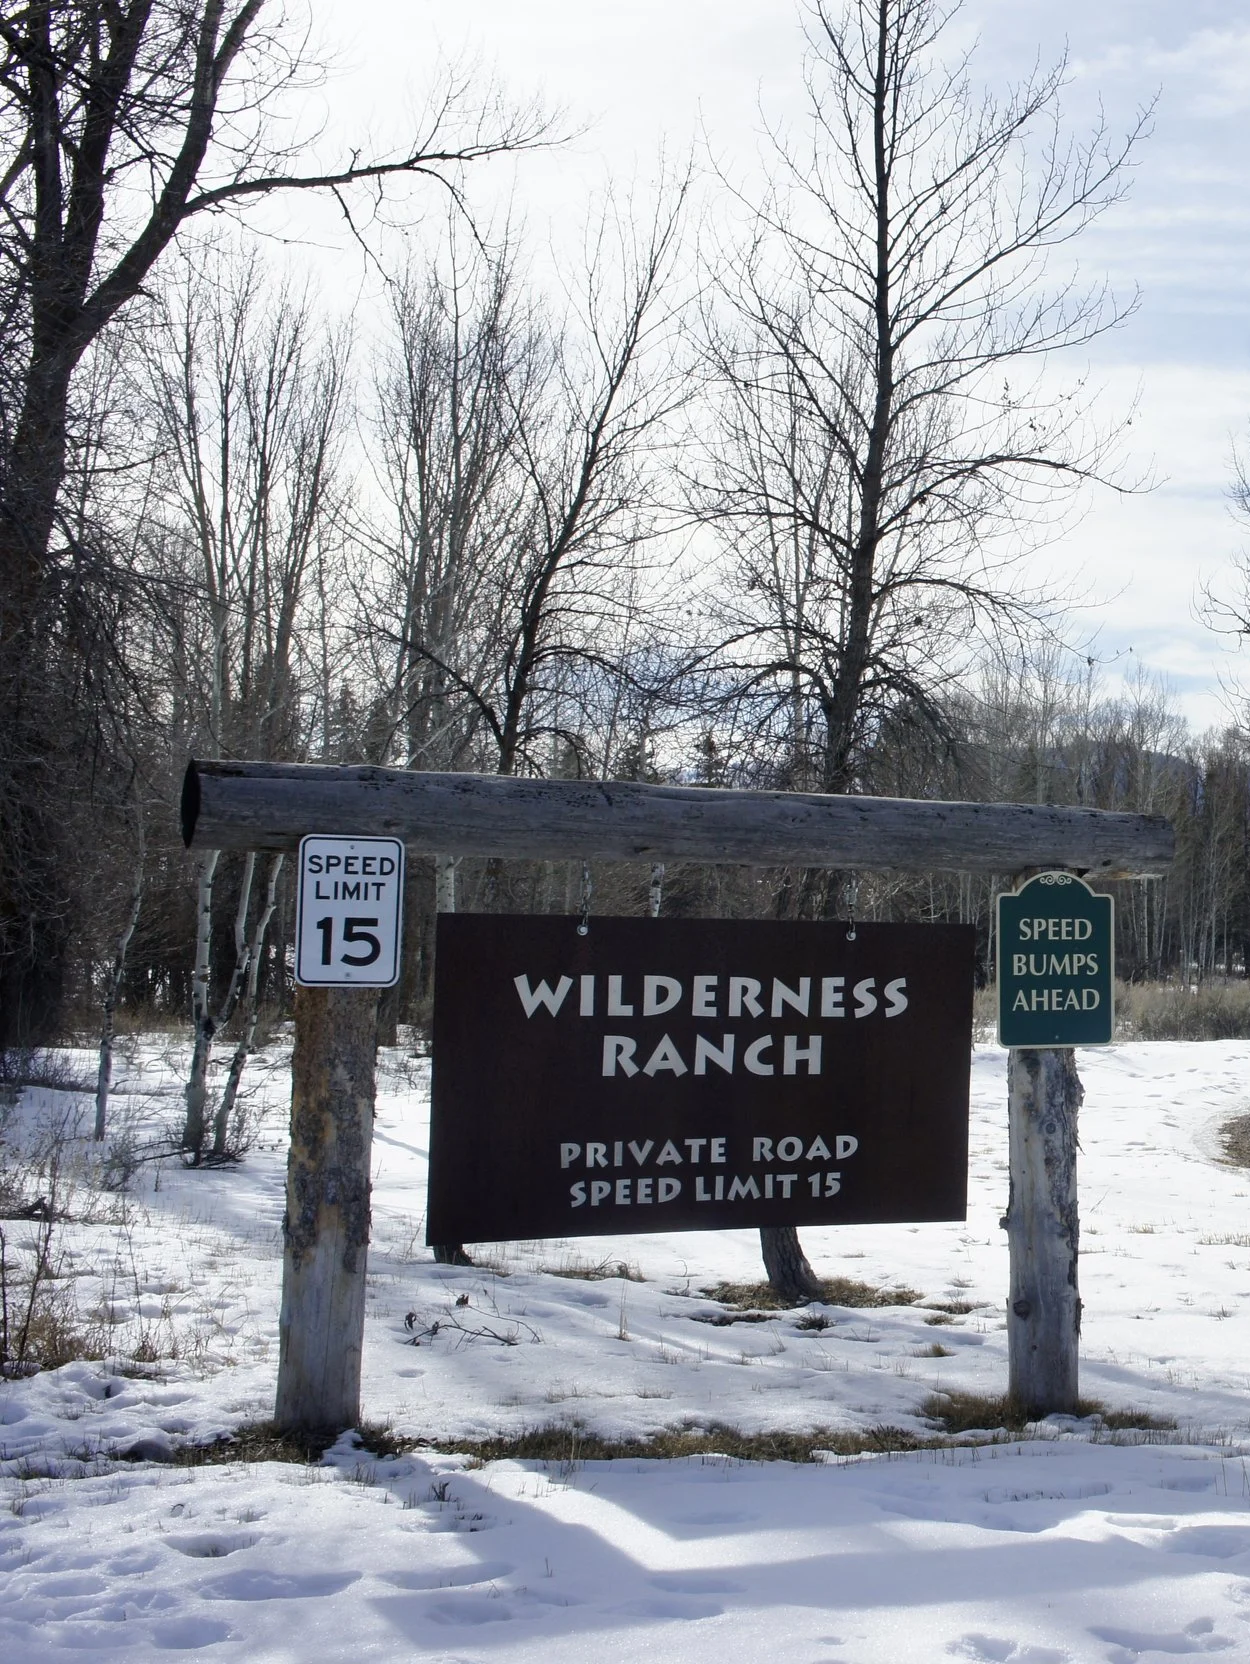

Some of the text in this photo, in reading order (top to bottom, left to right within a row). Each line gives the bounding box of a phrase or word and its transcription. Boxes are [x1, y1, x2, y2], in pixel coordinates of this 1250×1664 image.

[308, 854, 395, 876] SPEED
[315, 881, 386, 902] LIMIT
[316, 916, 382, 967] 15
[1019, 918, 1092, 941] SPEED
[1013, 953, 1099, 976] BUMPS
[513, 974, 908, 1019] WILDERNESS
[1012, 988, 1100, 1012] AHEAD
[602, 1033, 822, 1078] RANCH
[560, 1134, 859, 1169] PRIVATE ROAD
[570, 1172, 842, 1208] SPEED LIMIT 15
